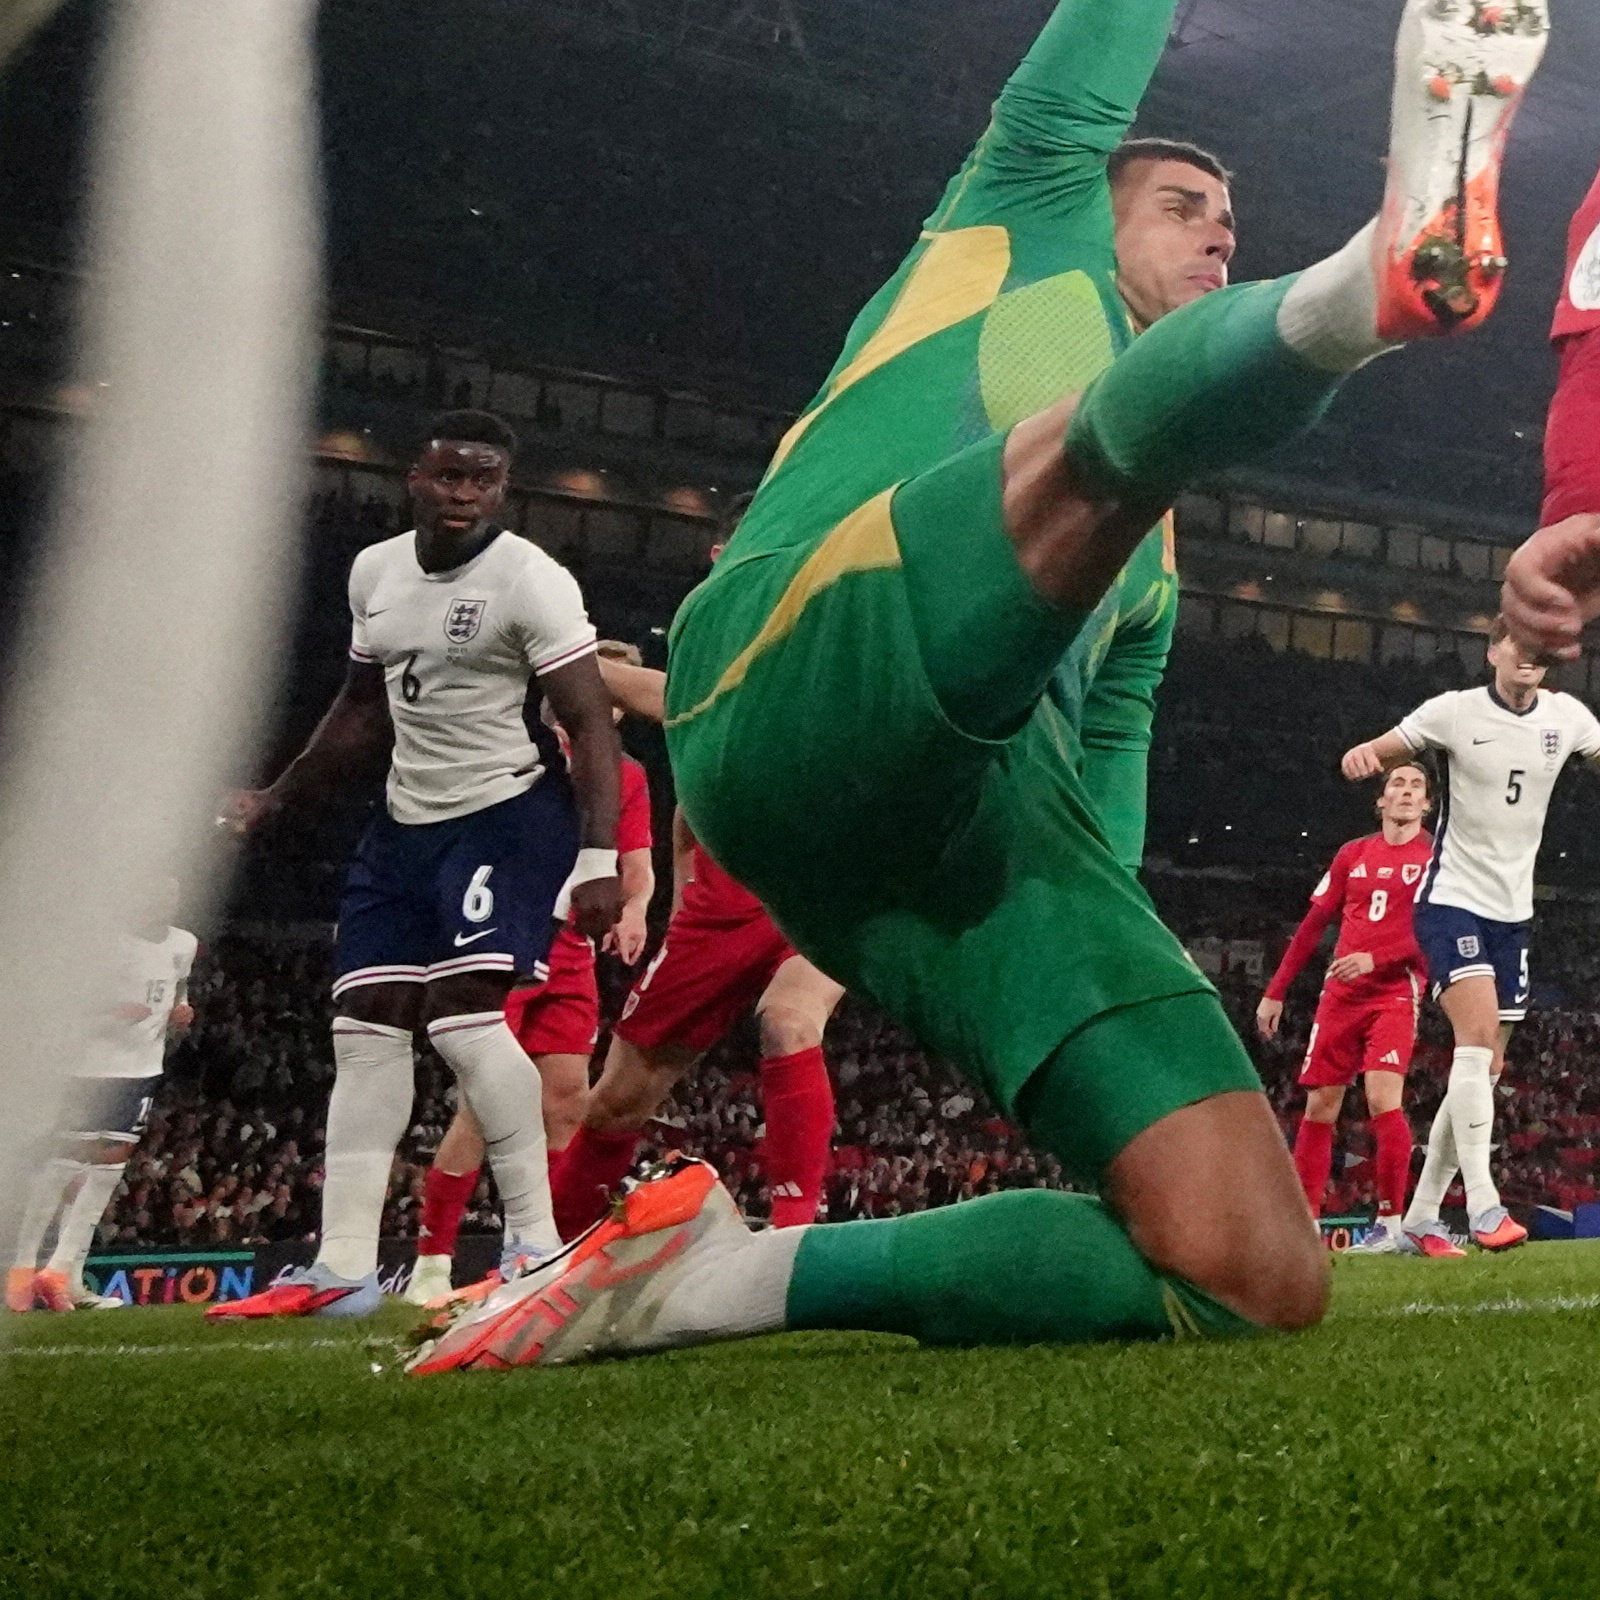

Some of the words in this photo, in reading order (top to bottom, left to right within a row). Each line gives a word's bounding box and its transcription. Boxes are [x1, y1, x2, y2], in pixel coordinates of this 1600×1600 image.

[402, 648, 421, 704] 6
[1505, 769, 1526, 805] 5
[462, 865, 494, 923] 6
[1368, 890, 1388, 922] 8
